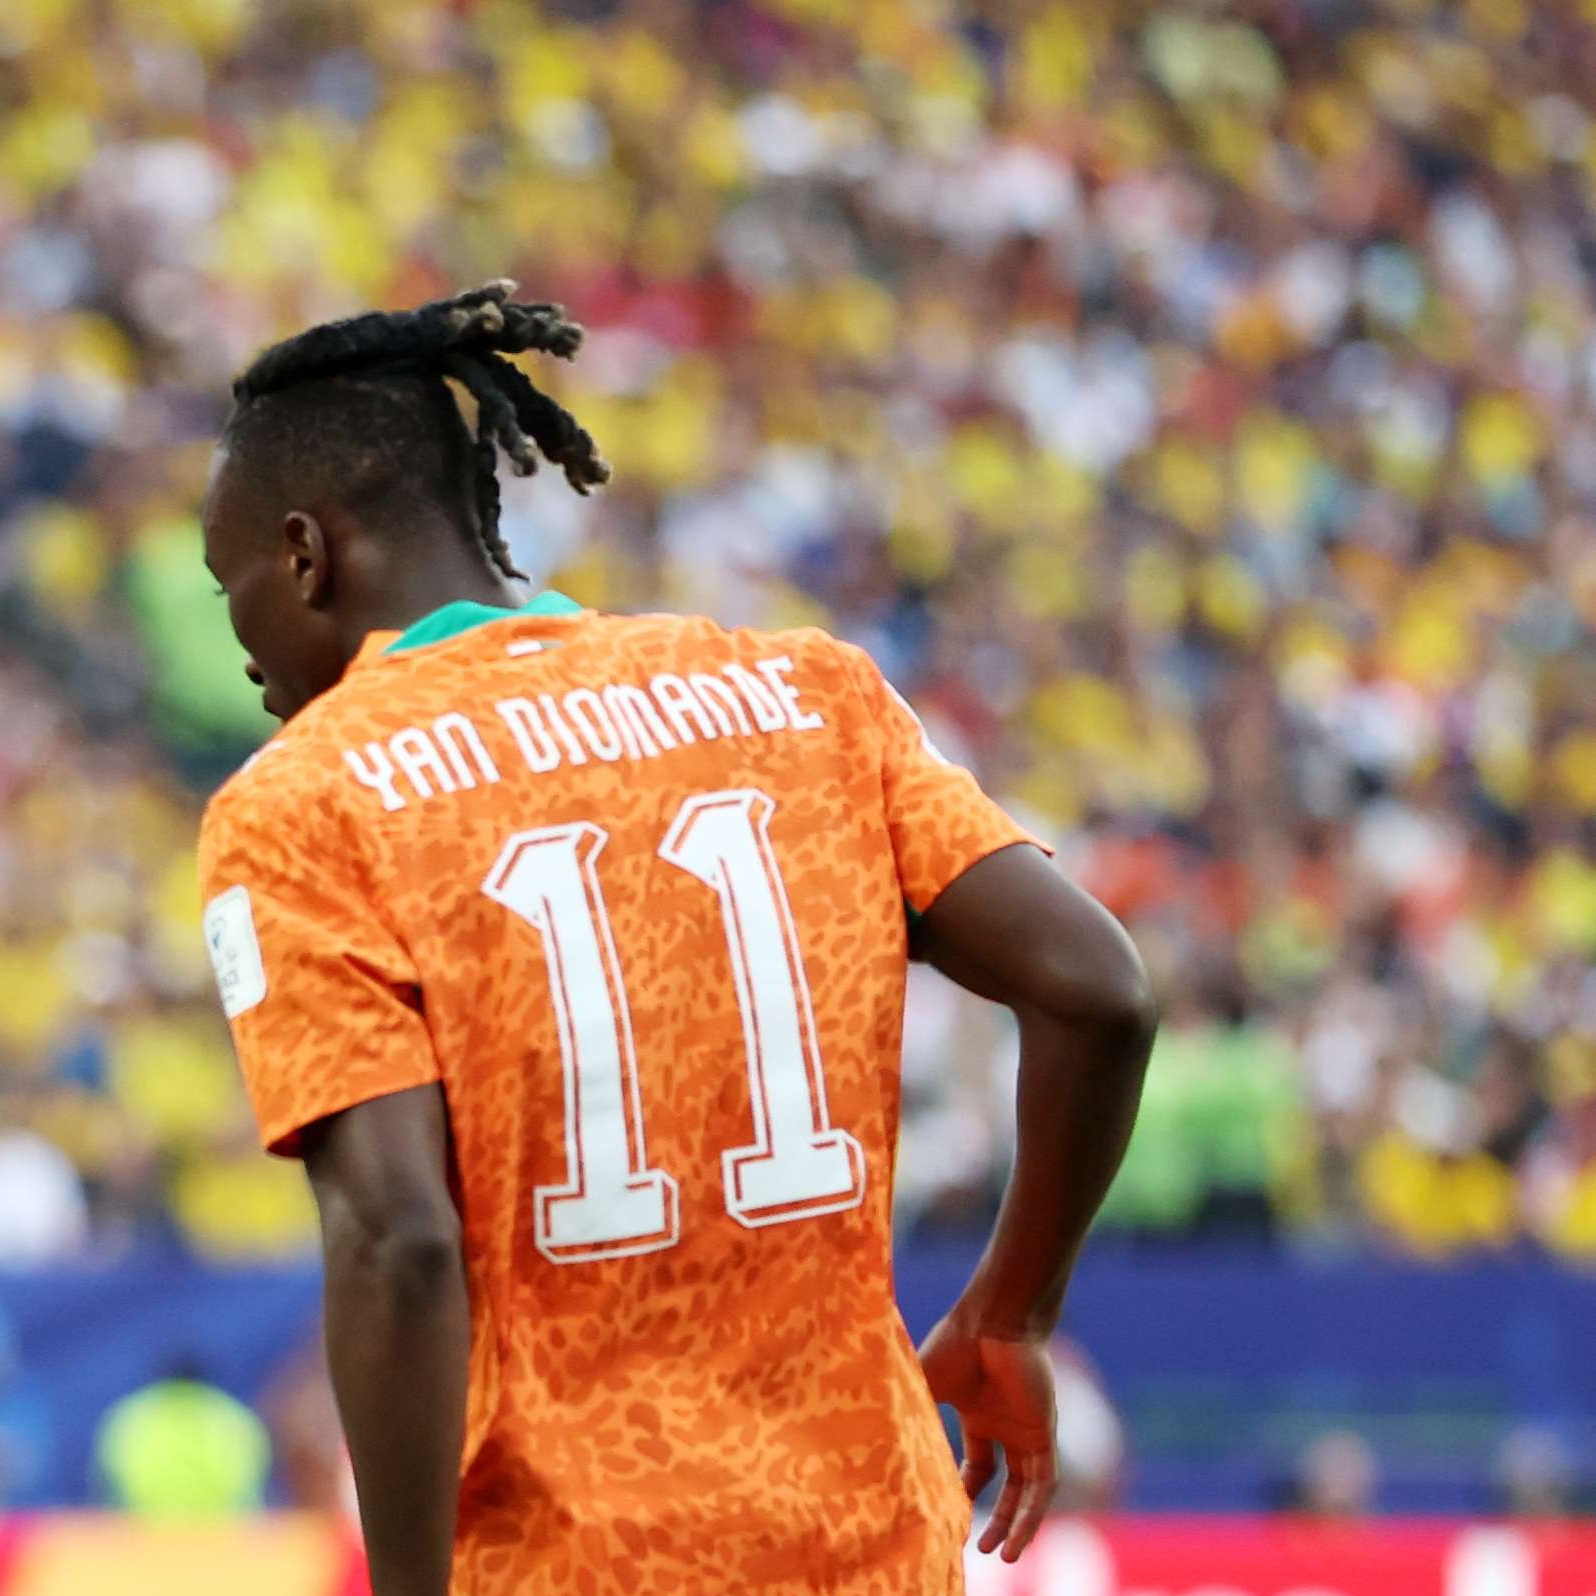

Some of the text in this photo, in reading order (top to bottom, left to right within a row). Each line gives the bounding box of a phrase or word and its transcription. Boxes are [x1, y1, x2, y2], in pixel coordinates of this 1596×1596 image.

[343, 655, 825, 813] YAN DIOMANDE
[481, 787, 865, 1265] 11
